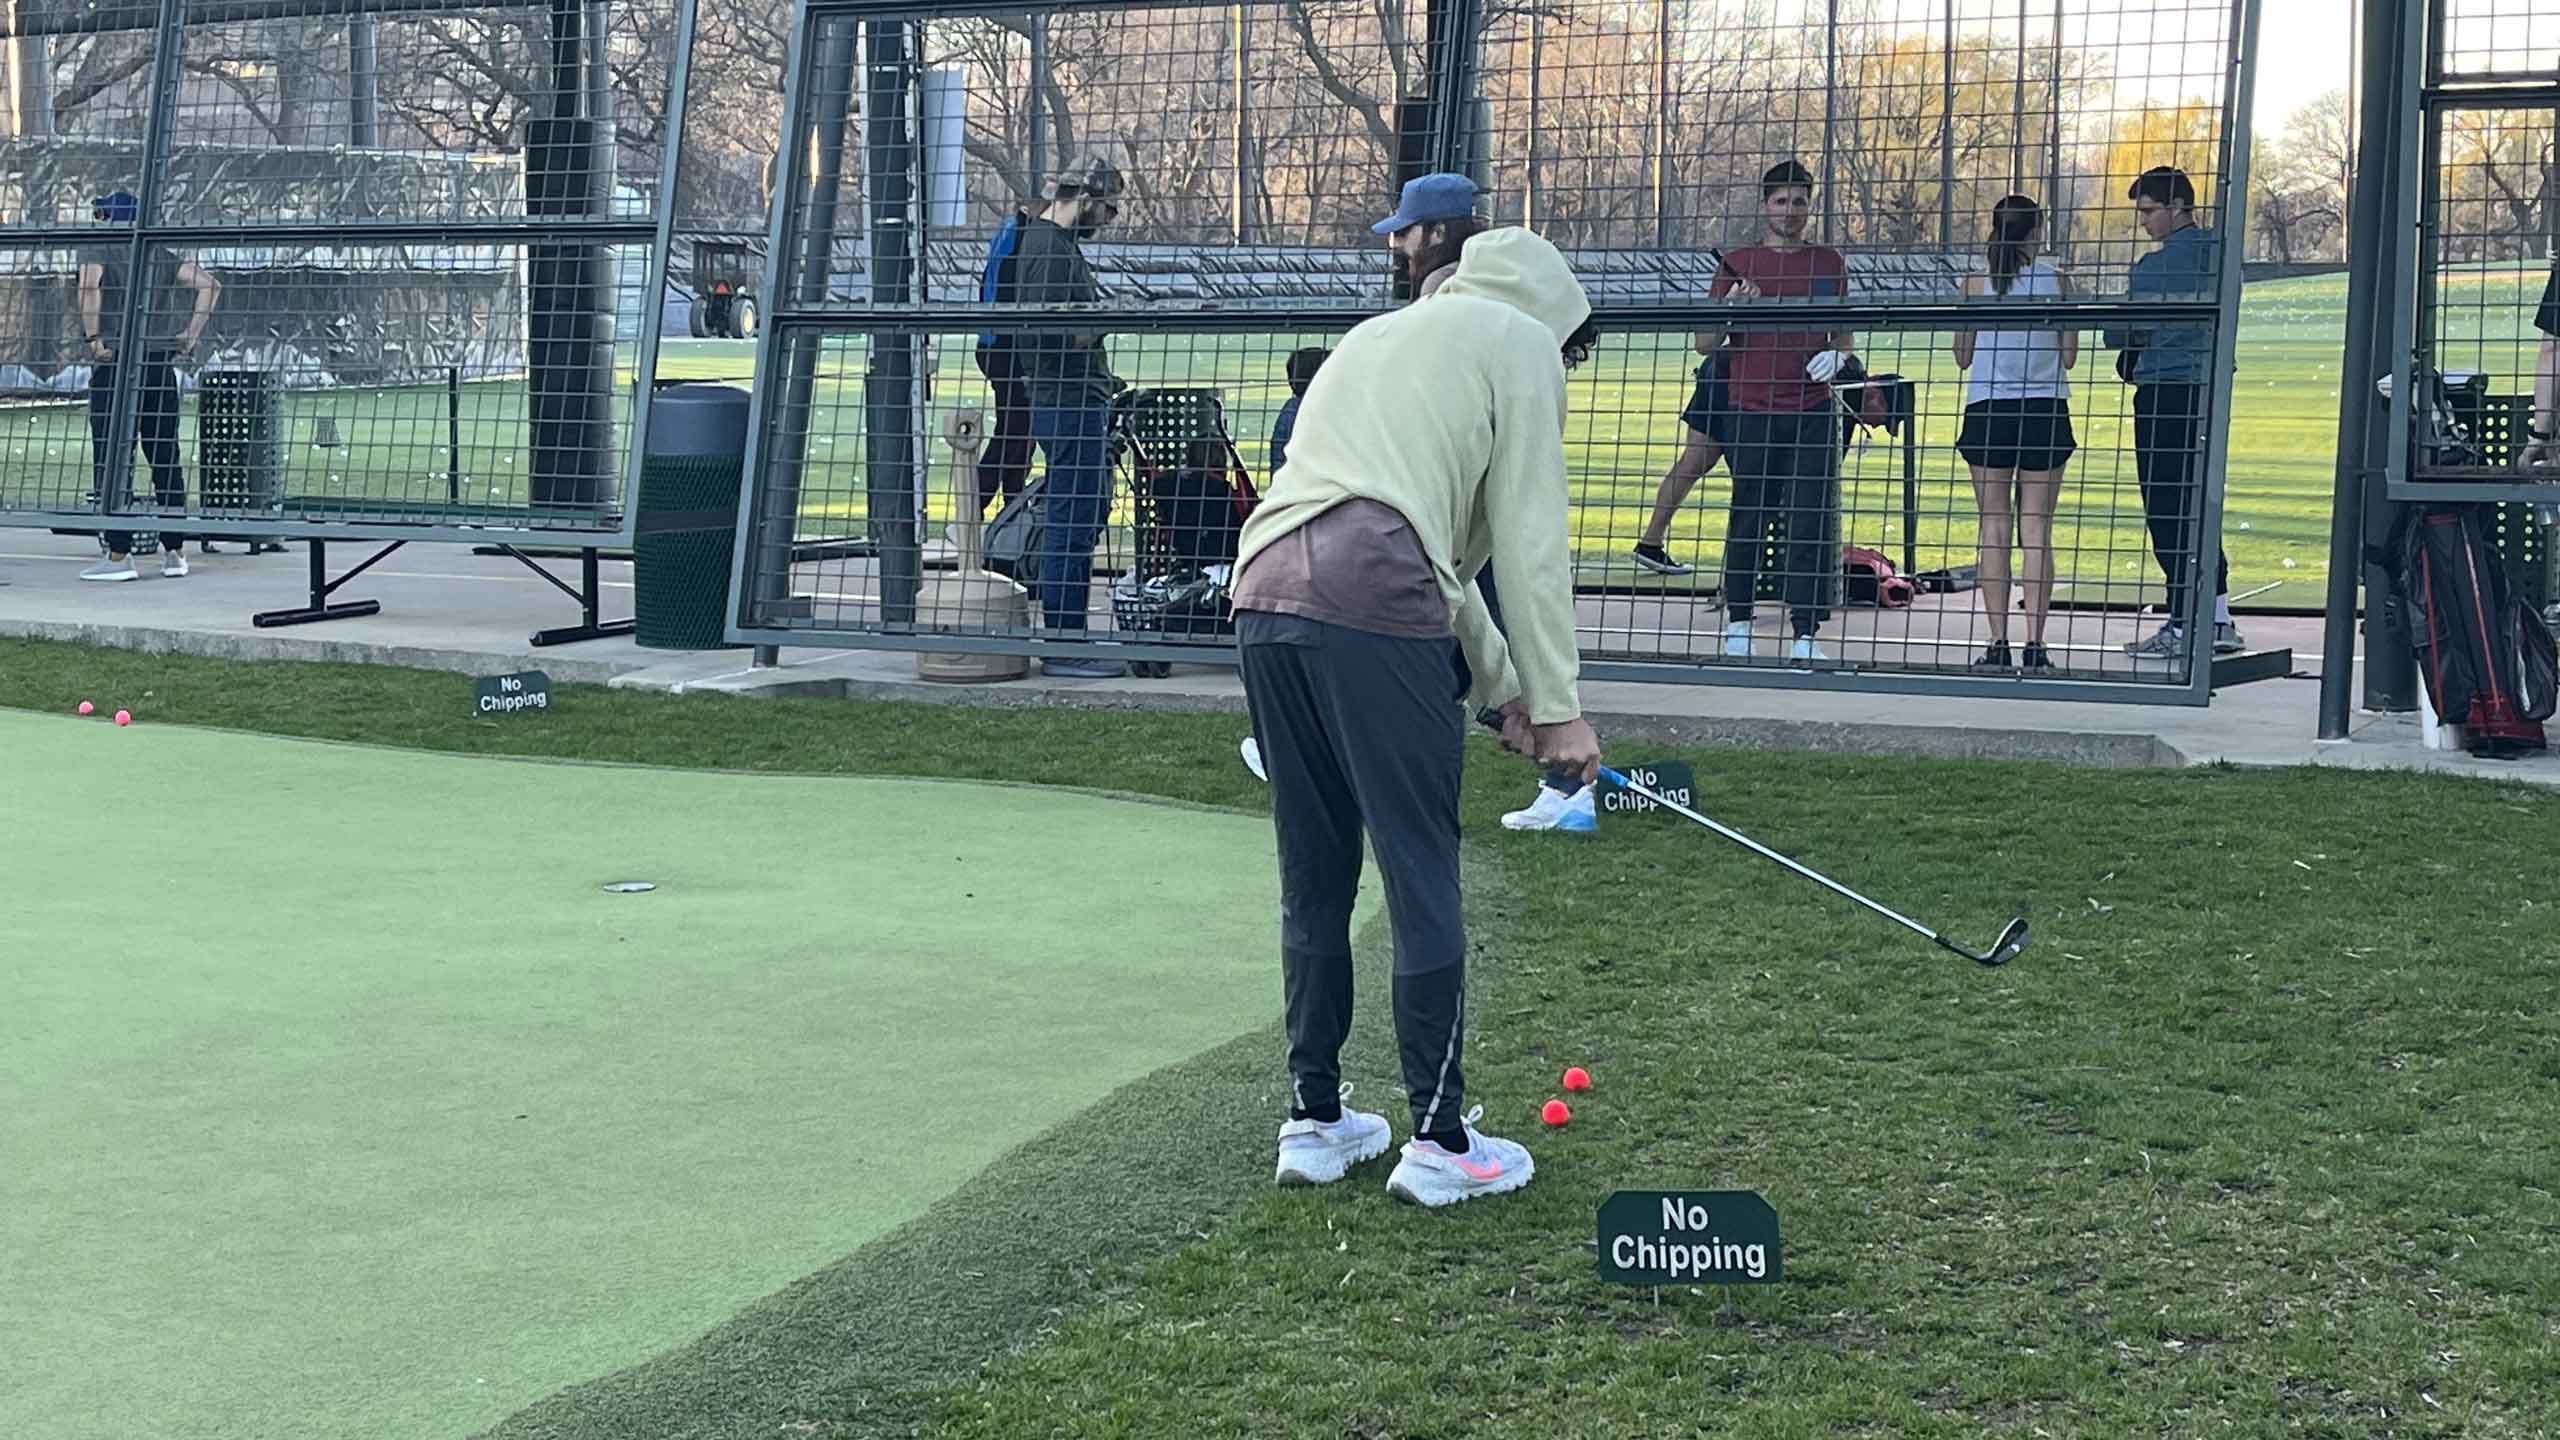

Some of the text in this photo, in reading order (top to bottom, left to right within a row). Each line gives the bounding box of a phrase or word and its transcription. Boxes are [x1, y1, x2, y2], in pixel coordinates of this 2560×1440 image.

[501, 676, 522, 692] No
[480, 692, 547, 713] Chipping
[1630, 768, 1657, 786] No
[1661, 1197, 1709, 1231] No
[1611, 1234, 1766, 1278] Chipping
